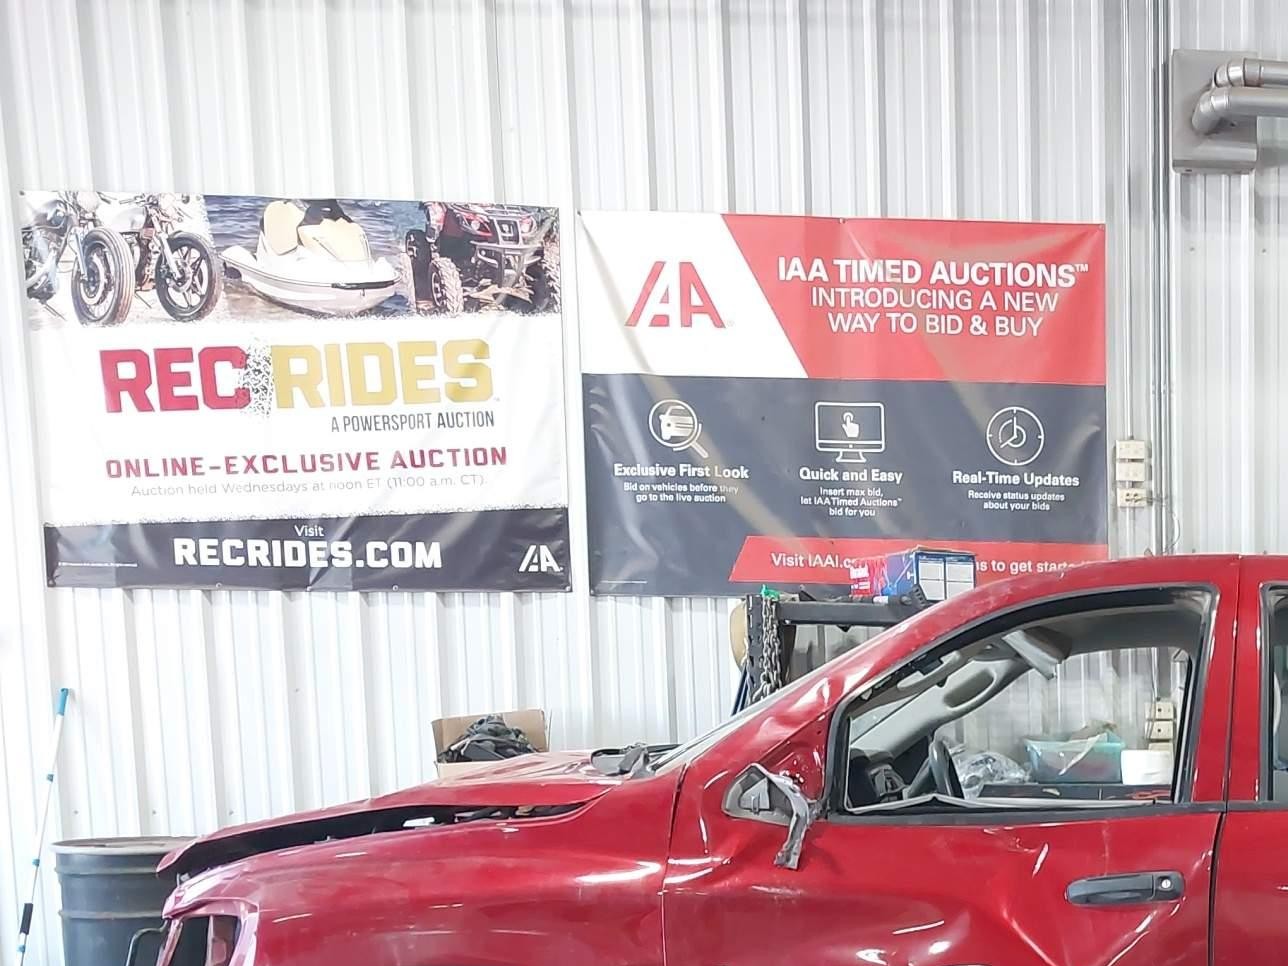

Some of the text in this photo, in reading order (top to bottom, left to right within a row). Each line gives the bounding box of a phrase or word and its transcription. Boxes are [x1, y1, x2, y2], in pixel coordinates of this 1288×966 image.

[778, 256, 829, 282] IAA
[832, 258, 921, 284] TIMED
[812, 286, 1059, 312] INTRODUCING A NEW
[828, 312, 1043, 336] WAY TO BID & BUY
[271, 338, 494, 409] RIDES
[331, 410, 495, 433] A POWERSPORT AUCTION
[106, 446, 507, 478] ONLINE-EXCLUSIVE AUCTION
[613, 463, 749, 479] Exclusive First Look
[800, 467, 903, 485] Quick and Easy
[952, 470, 1080, 488] Real-Time Updates
[131, 485, 184, 497] Auction
[188, 483, 217, 494] held
[221, 481, 308, 495] Wednesdays
[312, 479, 325, 491] at
[329, 480, 362, 490] noon
[367, 477, 381, 488] ET
[623, 482, 739, 494] Bid on vehicles before they
[820, 487, 844, 496] Insert
[846, 488, 866, 496] max
[968, 489, 1065, 502] Receive status updates
[636, 492, 726, 503] go to the live auction
[800, 496, 812, 505] let
[814, 496, 831, 505] IAA
[831, 497, 859, 506] Timed
[983, 501, 1050, 511] about your bids
[829, 507, 876, 517] bid for you
[293, 524, 324, 537] Visit
[173, 538, 442, 568] RECRIDES.COM
[770, 552, 804, 567] Visit
[991, 560, 1006, 572] to
[1010, 560, 1032, 575] get
